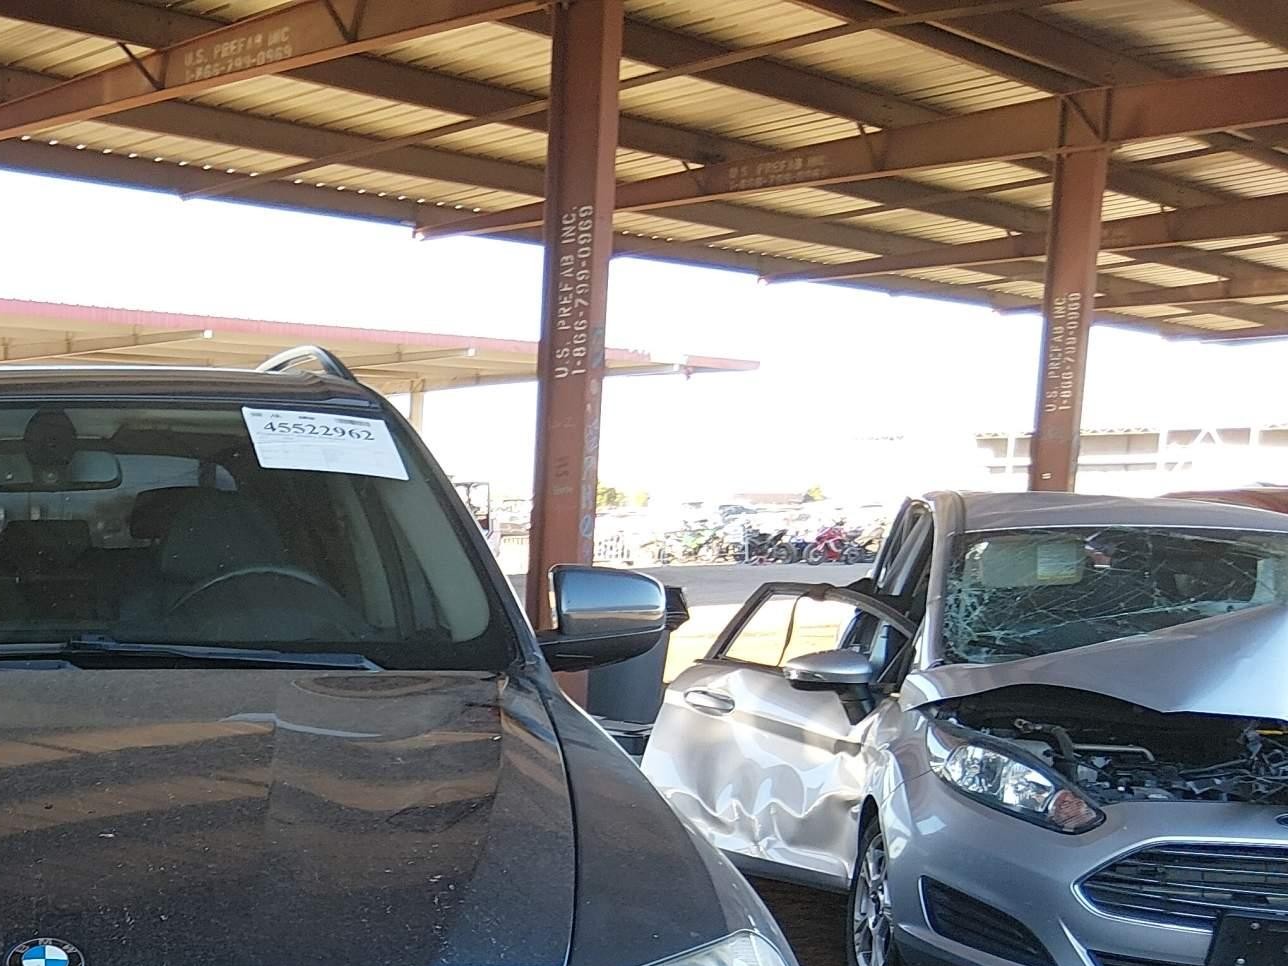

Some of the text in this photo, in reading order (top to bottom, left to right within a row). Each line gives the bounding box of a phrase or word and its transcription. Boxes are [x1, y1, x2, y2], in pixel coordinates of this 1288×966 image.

[554, 206, 577, 378] U.S. PREFAB INC.
[571, 205, 593, 375] 1-866-799-0969
[263, 421, 375, 441] 45522962
